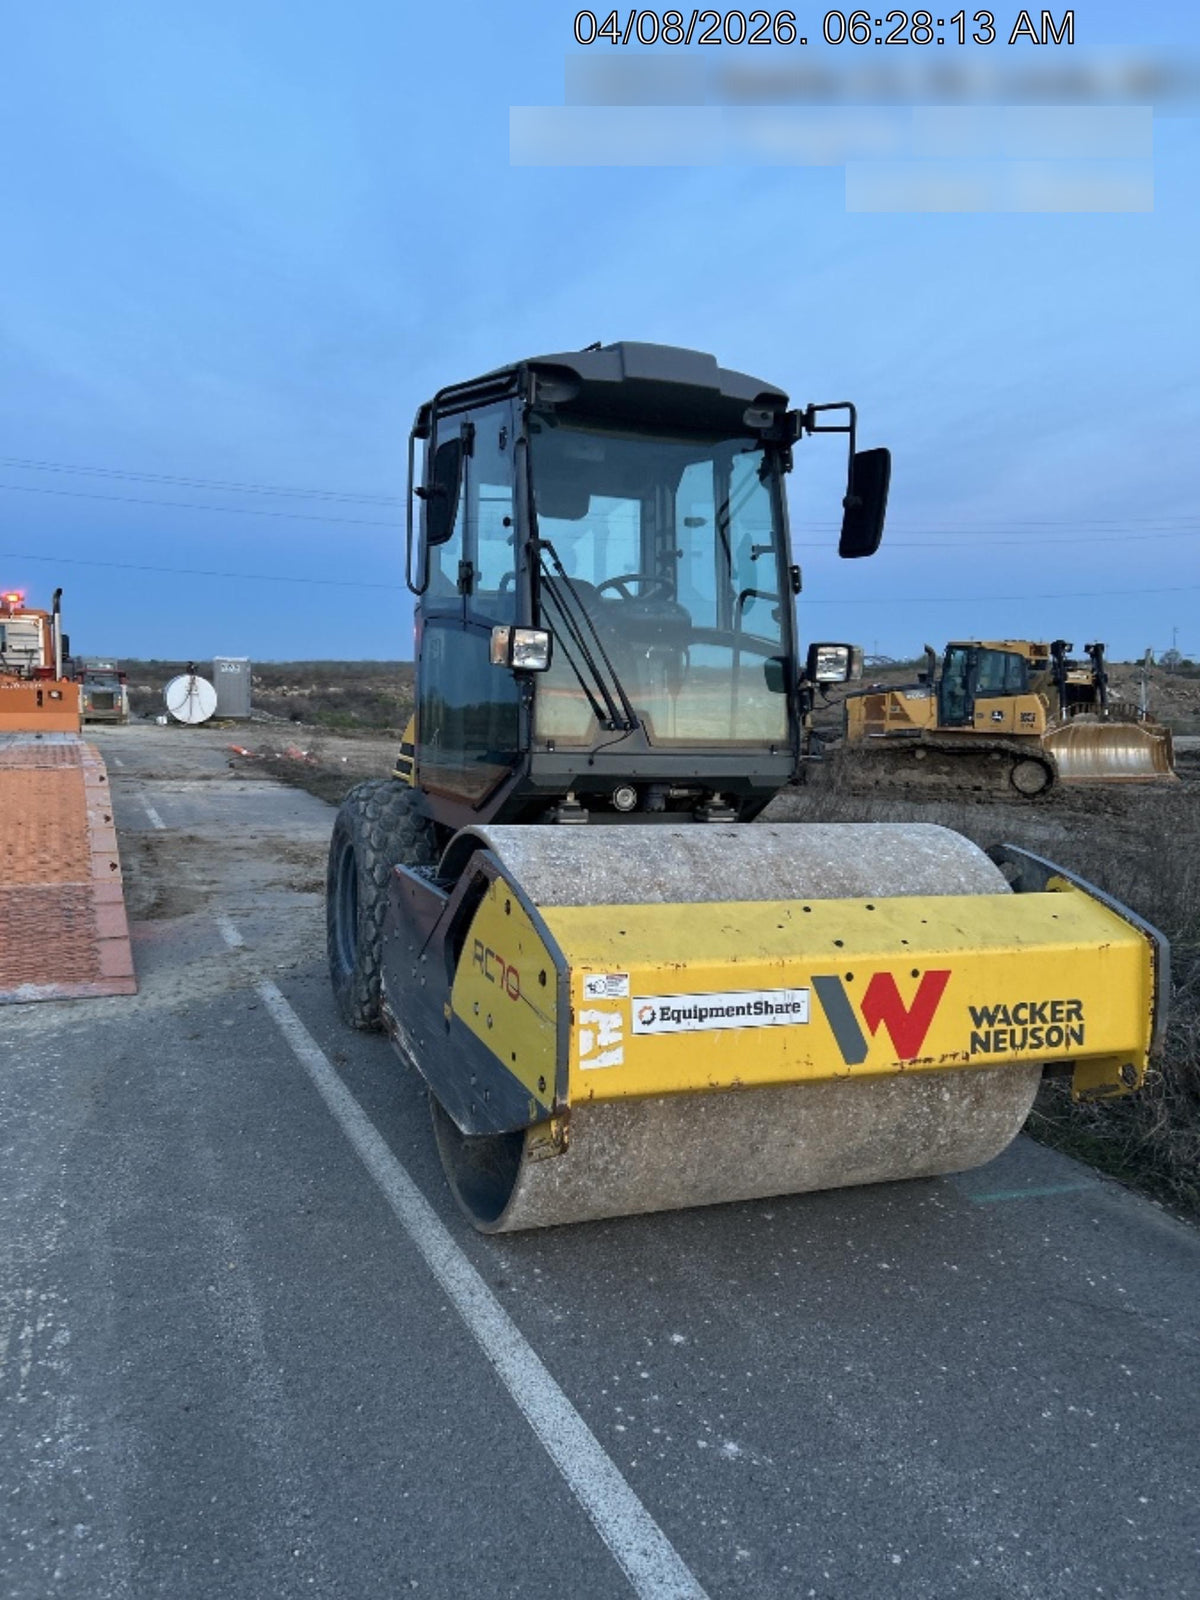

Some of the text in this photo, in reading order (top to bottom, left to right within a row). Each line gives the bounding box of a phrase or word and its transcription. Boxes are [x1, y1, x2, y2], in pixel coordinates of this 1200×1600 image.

[472, 938, 520, 1001] RC70
[659, 1001, 802, 1024] EquipmentShare
[968, 999, 1085, 1028] WACKER
[970, 1024, 1085, 1055] NEUSON
